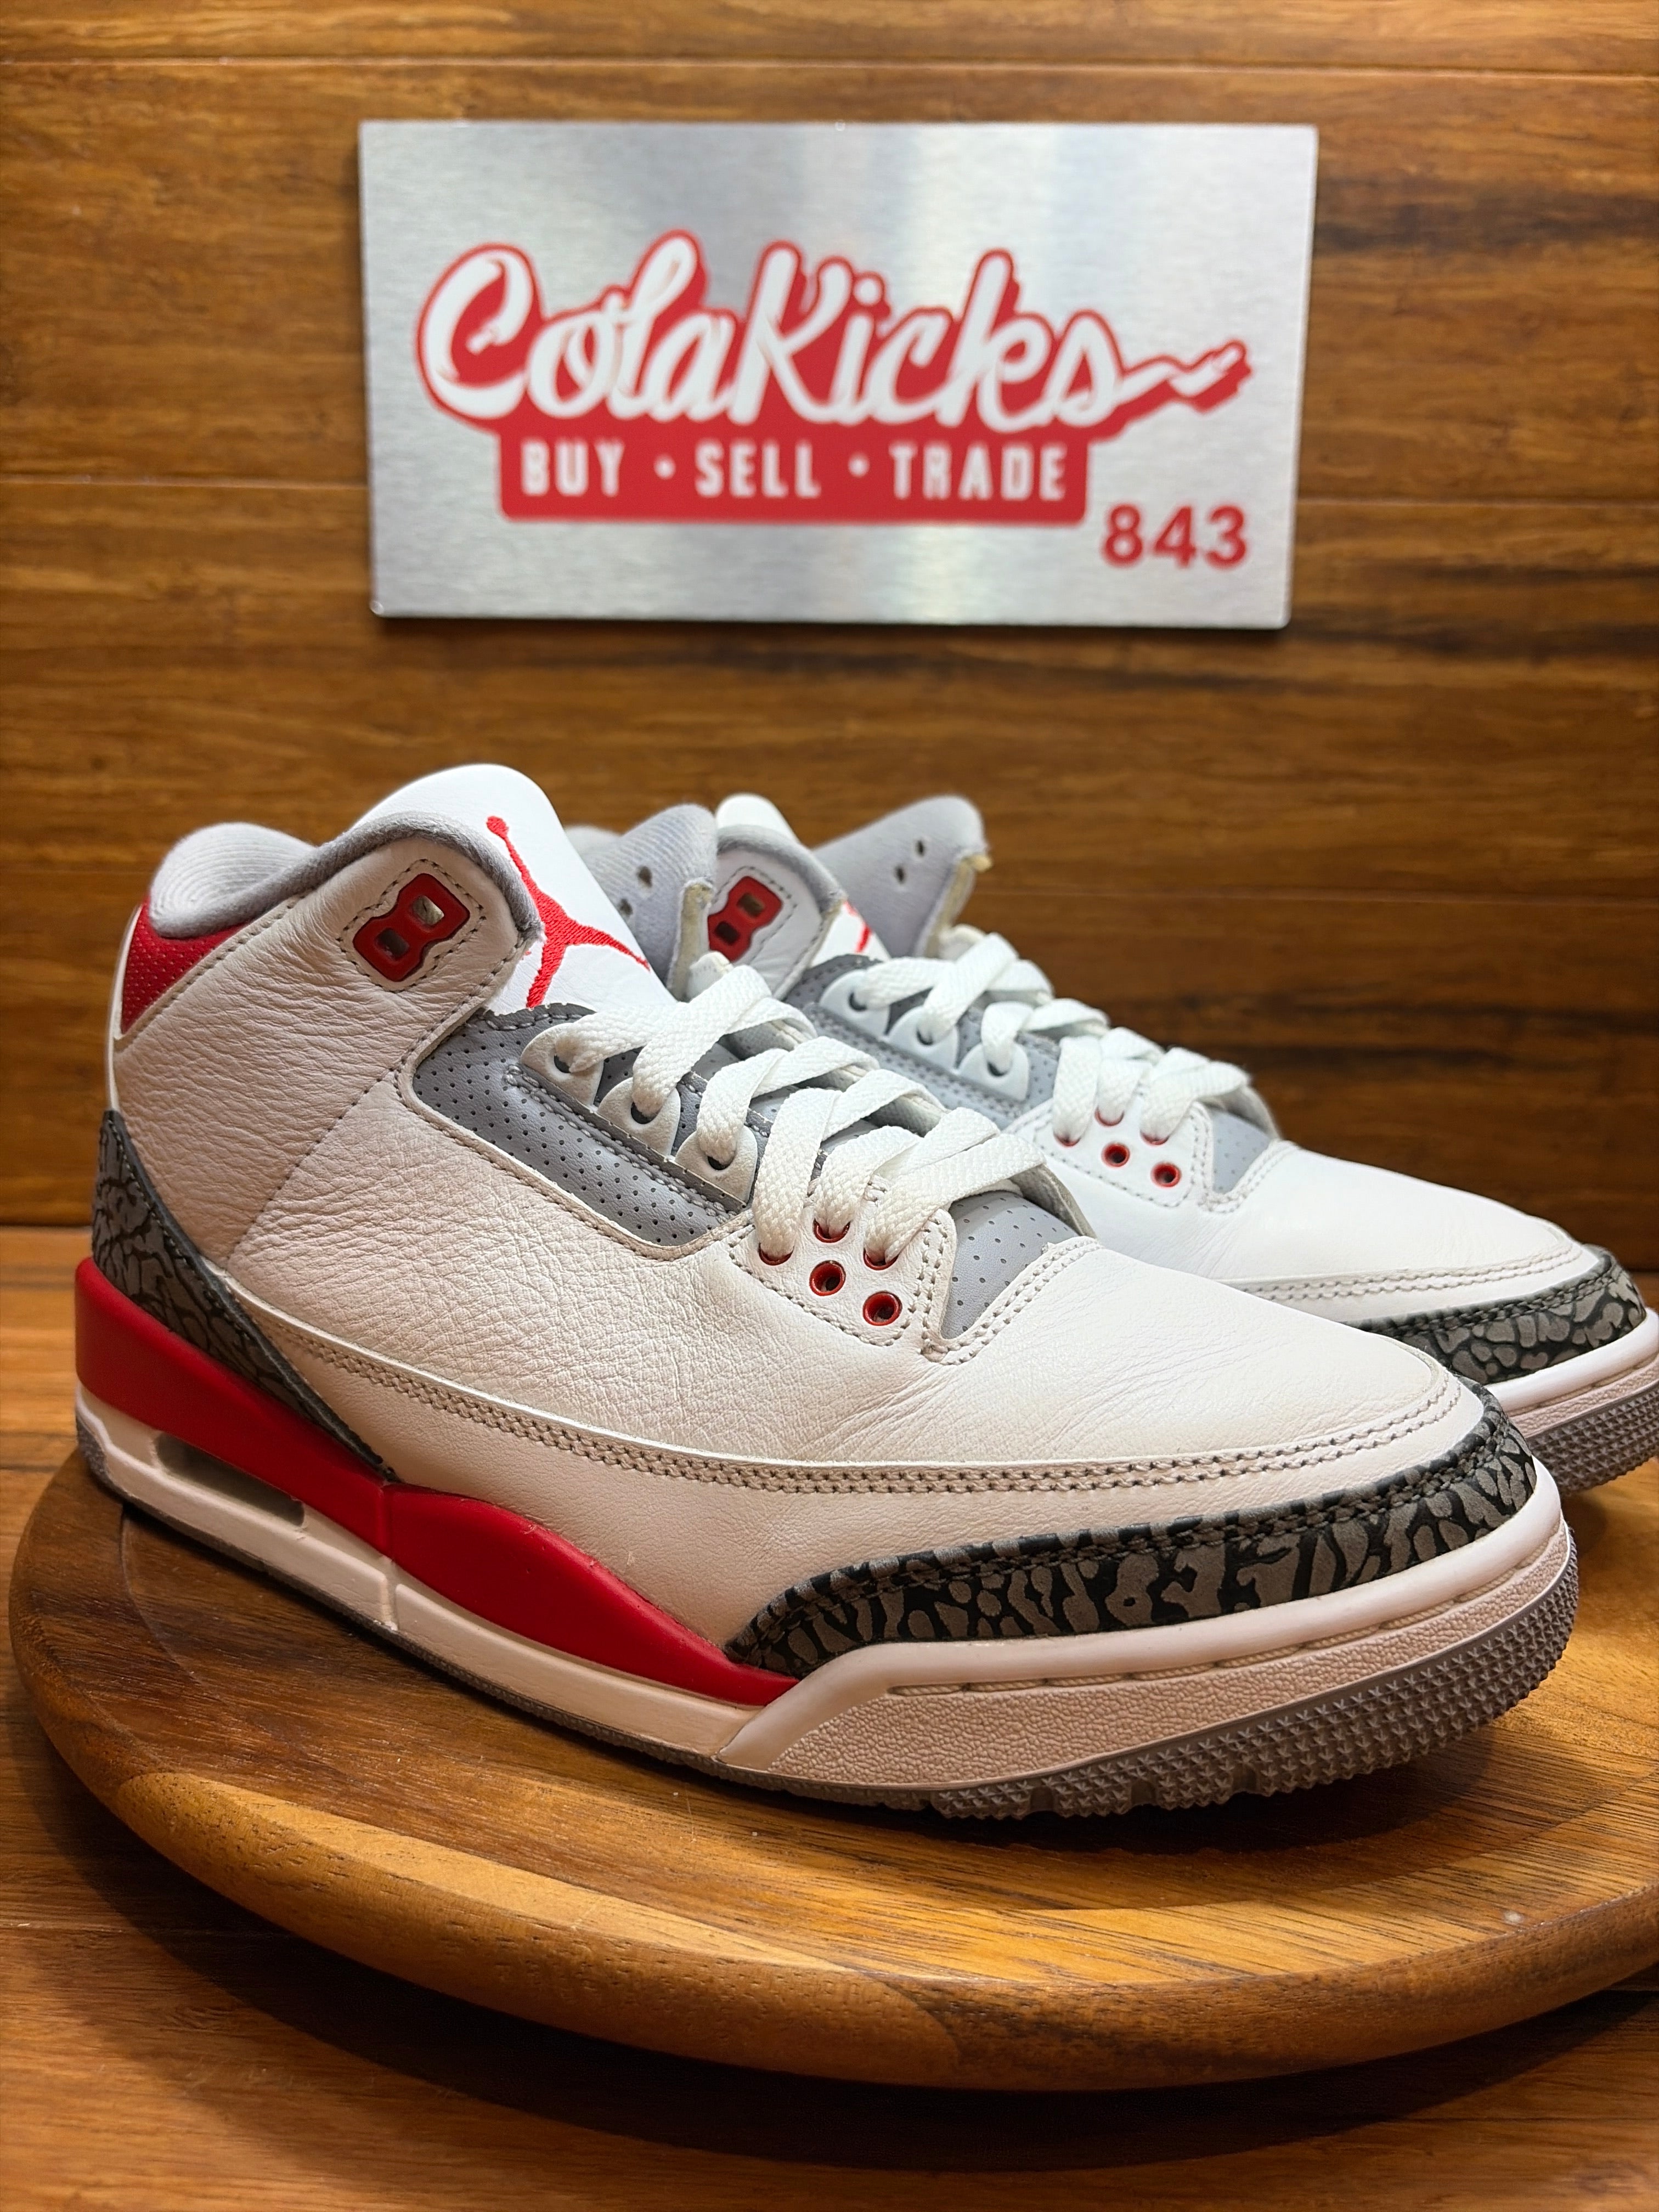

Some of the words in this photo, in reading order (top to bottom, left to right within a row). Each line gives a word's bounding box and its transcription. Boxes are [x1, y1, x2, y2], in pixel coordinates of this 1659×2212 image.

[418, 230, 1251, 433] ColaKicks
[521, 440, 624, 496] BUY
[695, 441, 820, 498] SELL
[890, 443, 1066, 501] TRADE
[1102, 504, 1248, 569] 843
